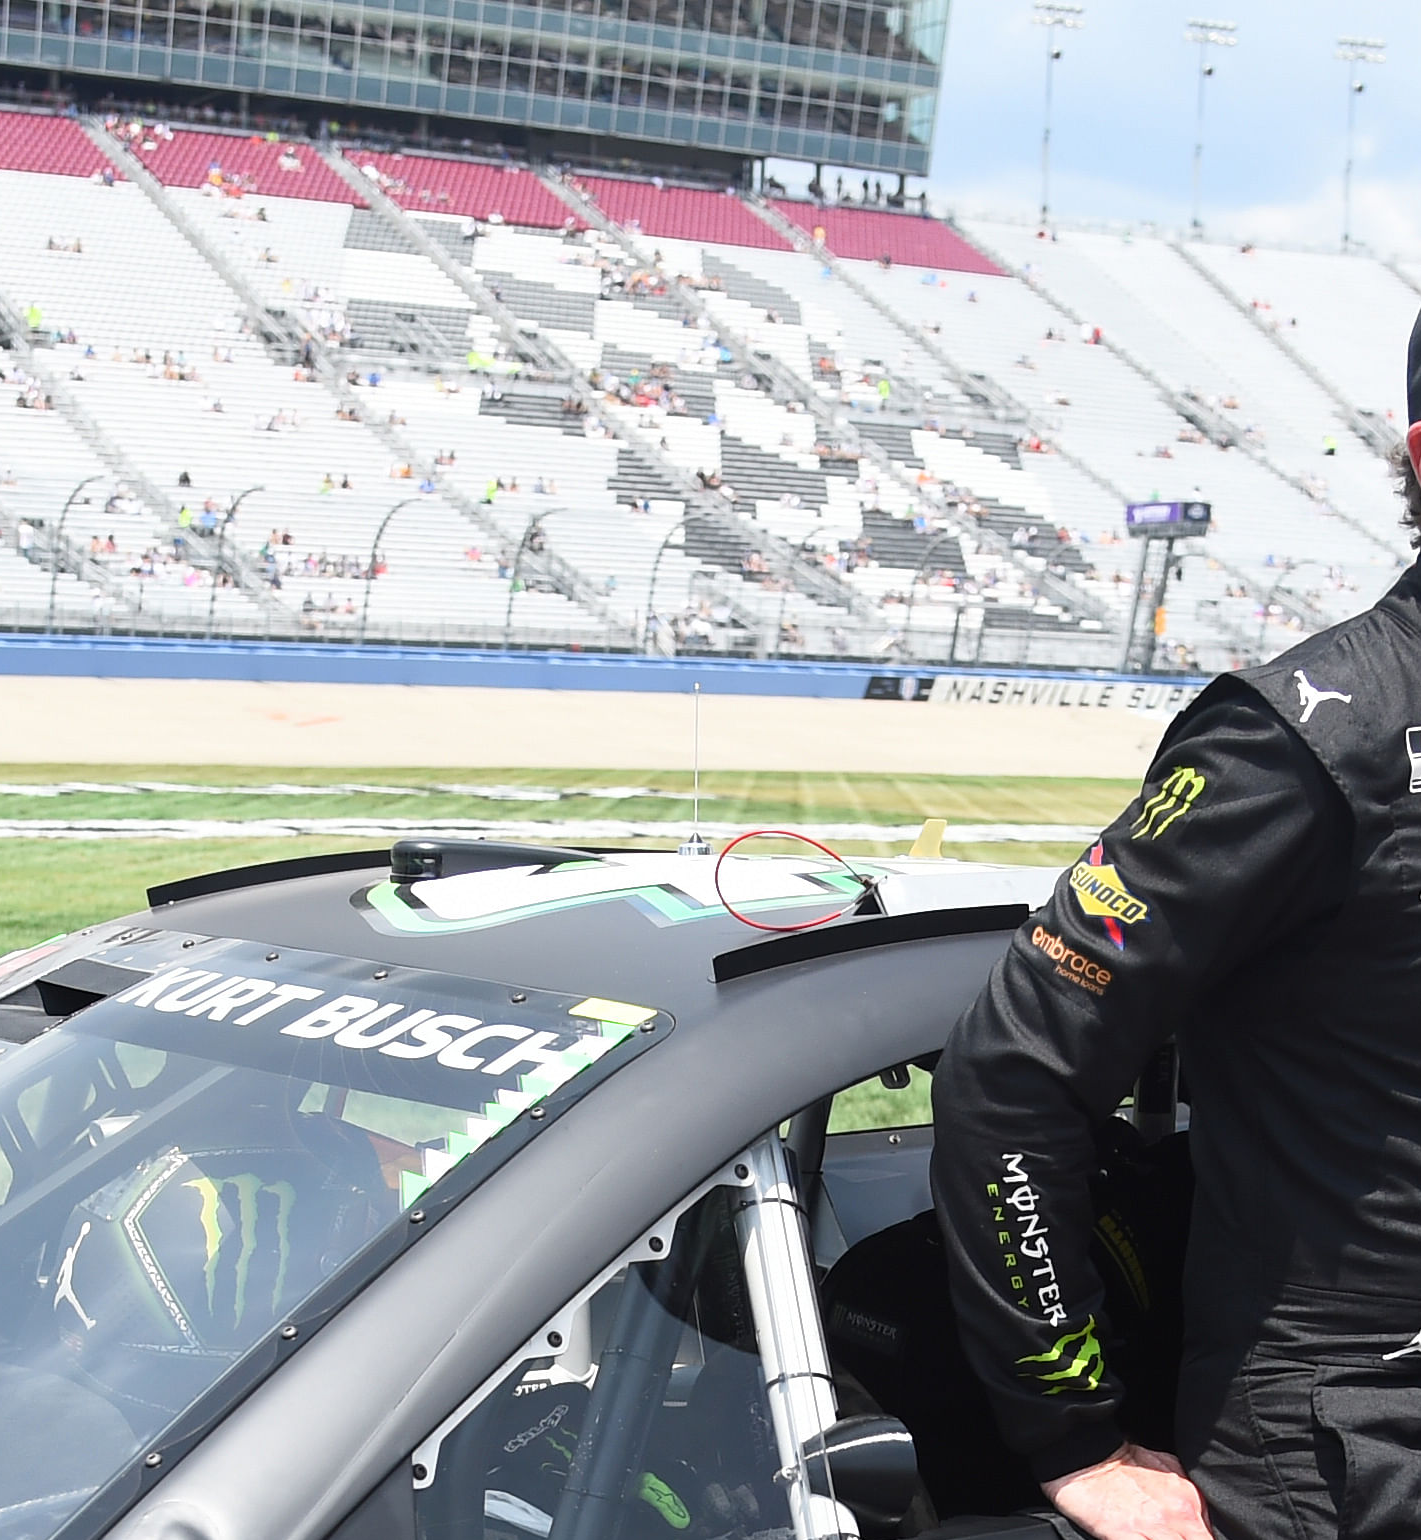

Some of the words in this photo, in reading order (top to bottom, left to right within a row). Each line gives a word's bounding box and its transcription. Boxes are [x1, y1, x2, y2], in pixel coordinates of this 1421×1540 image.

[946, 680, 1116, 707] NASHVILLE
[1071, 866, 1144, 921] SUNOCO
[1031, 925, 1114, 986] embrace
[116, 965, 324, 1027] KURT
[279, 996, 615, 1080] BUSCH
[986, 1182, 1030, 1309] ENERGY
